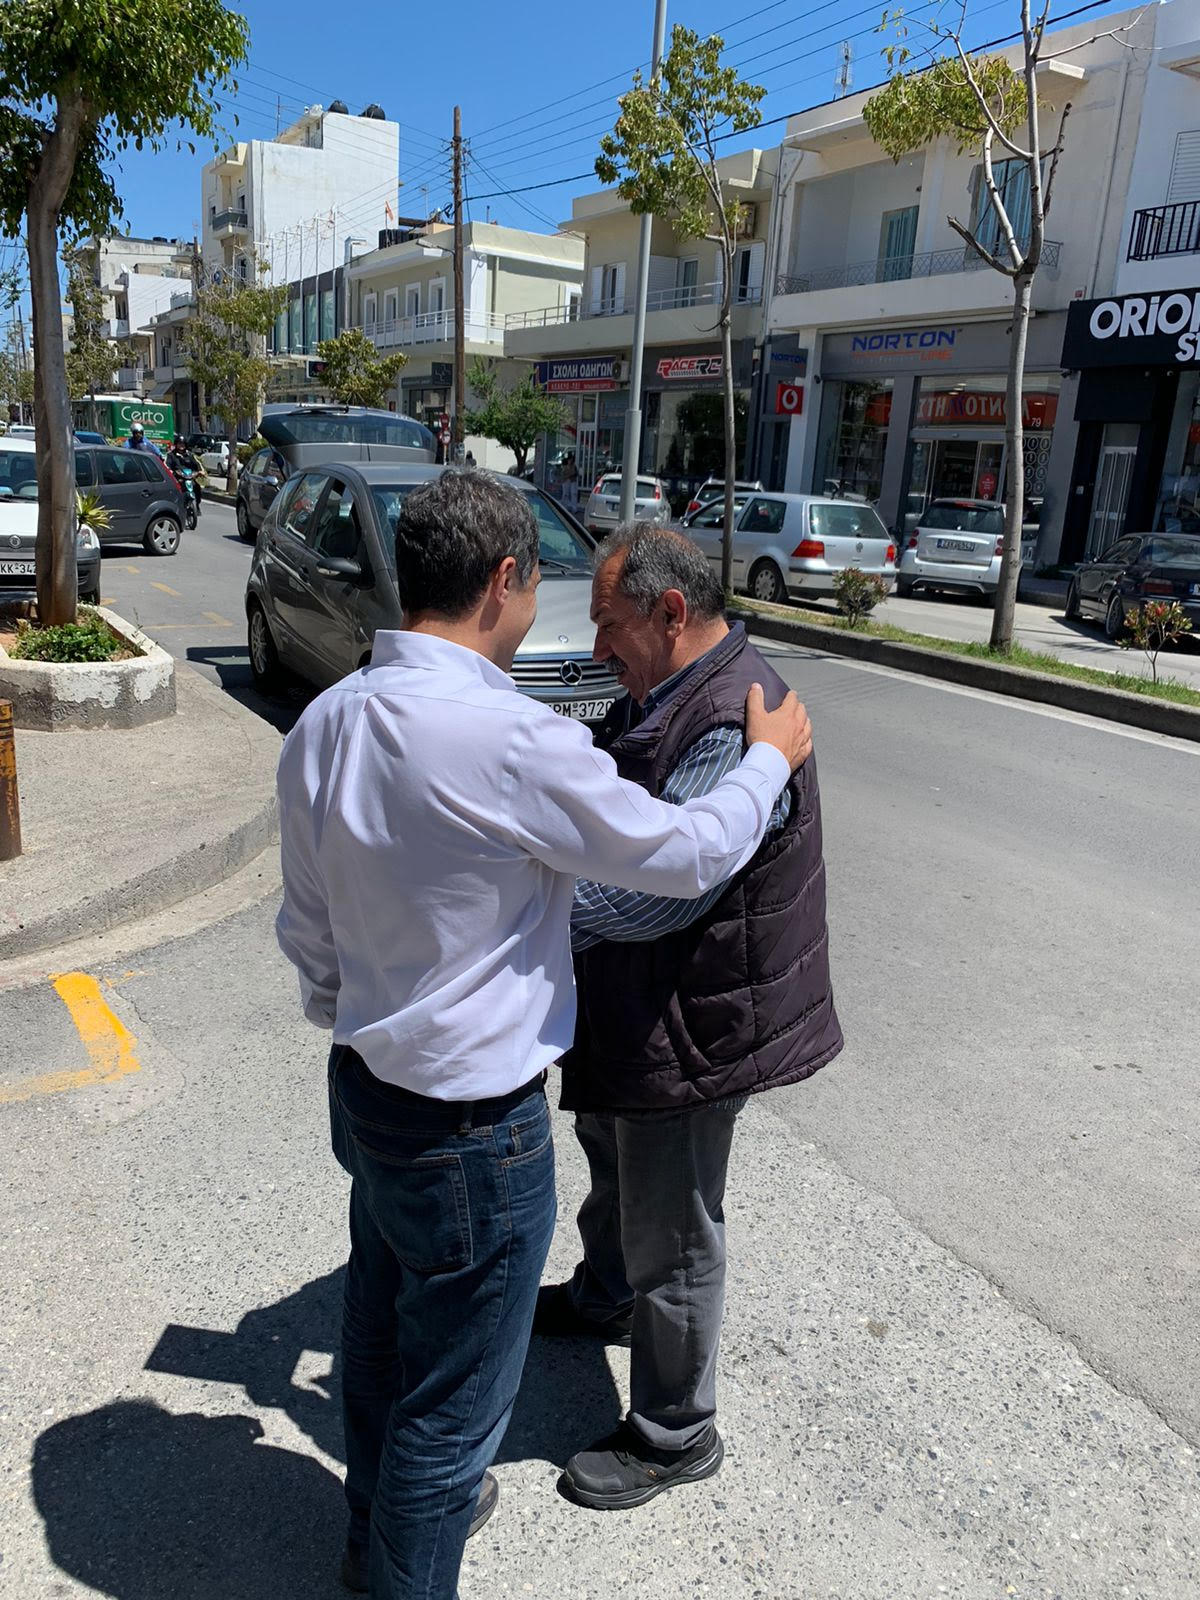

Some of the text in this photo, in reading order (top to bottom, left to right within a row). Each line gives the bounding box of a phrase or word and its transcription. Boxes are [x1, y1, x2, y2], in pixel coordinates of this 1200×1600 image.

[852, 329, 956, 351] NORTON
[552, 364, 578, 379] ΣΧΟΛΗ
[121, 405, 165, 424] Certo
[1031, 417, 1042, 427] 79
